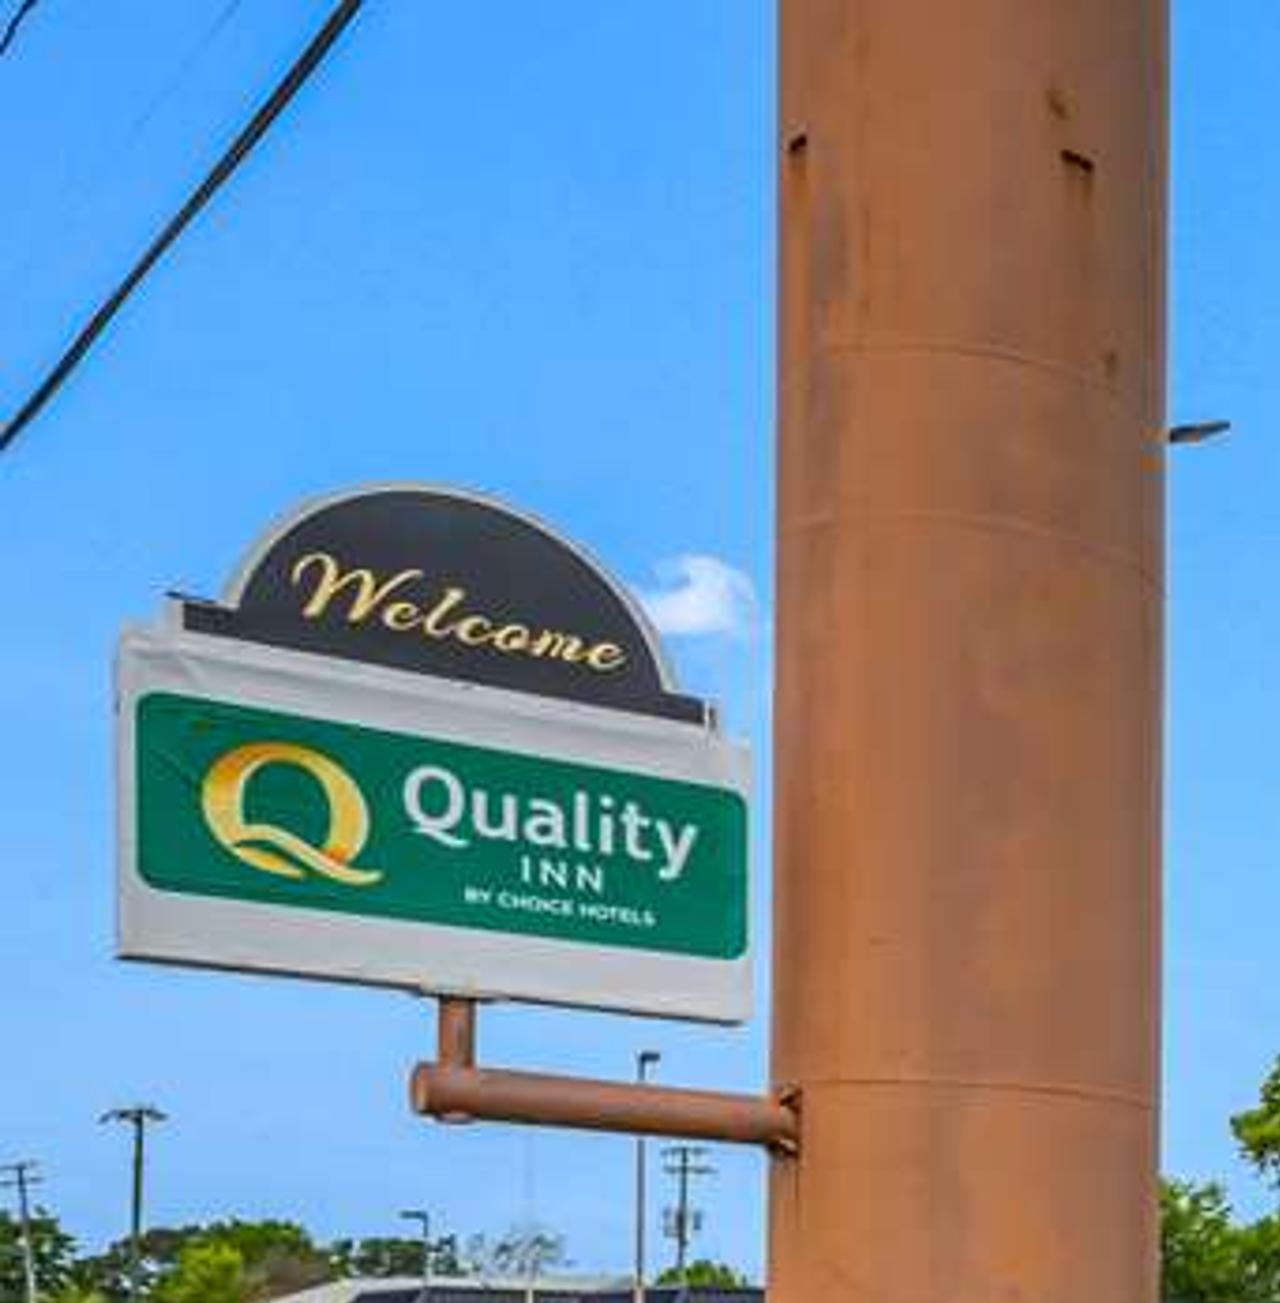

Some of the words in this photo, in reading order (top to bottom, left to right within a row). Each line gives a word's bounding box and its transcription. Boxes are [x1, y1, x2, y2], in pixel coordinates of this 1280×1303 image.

[292, 551, 628, 670] Welcome
[202, 741, 384, 886] Q
[403, 765, 698, 881] Quality
[464, 885, 492, 903] BY
[497, 890, 574, 916] CHOICE
[579, 902, 657, 927] HOTELS
[520, 854, 603, 893] INN
